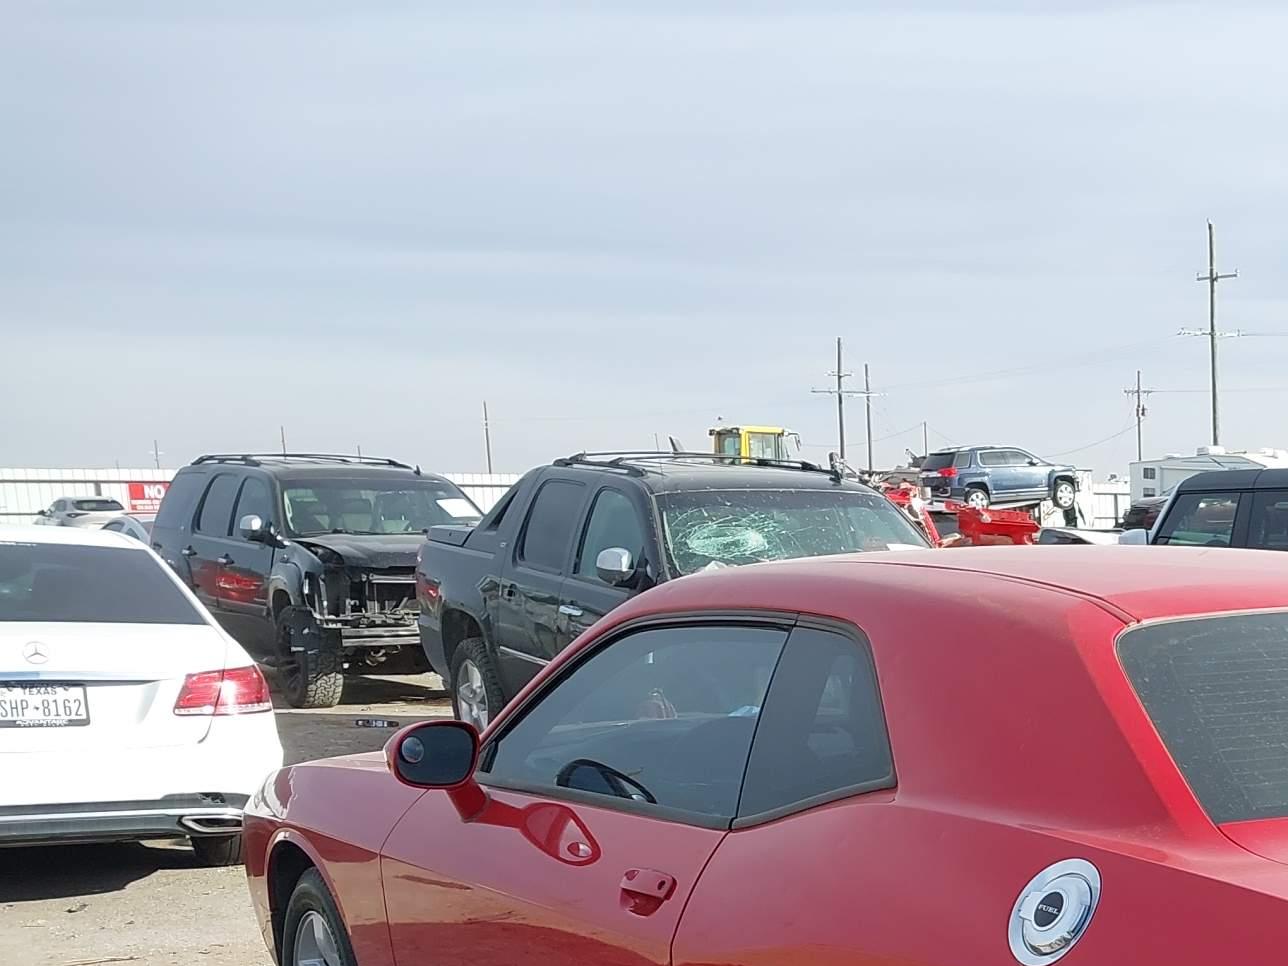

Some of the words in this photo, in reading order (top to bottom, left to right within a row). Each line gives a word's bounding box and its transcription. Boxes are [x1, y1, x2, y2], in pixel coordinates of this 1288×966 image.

[144, 484, 165, 499] NO
[21, 686, 57, 696] TEXAS
[1038, 904, 1060, 915] FUEL
